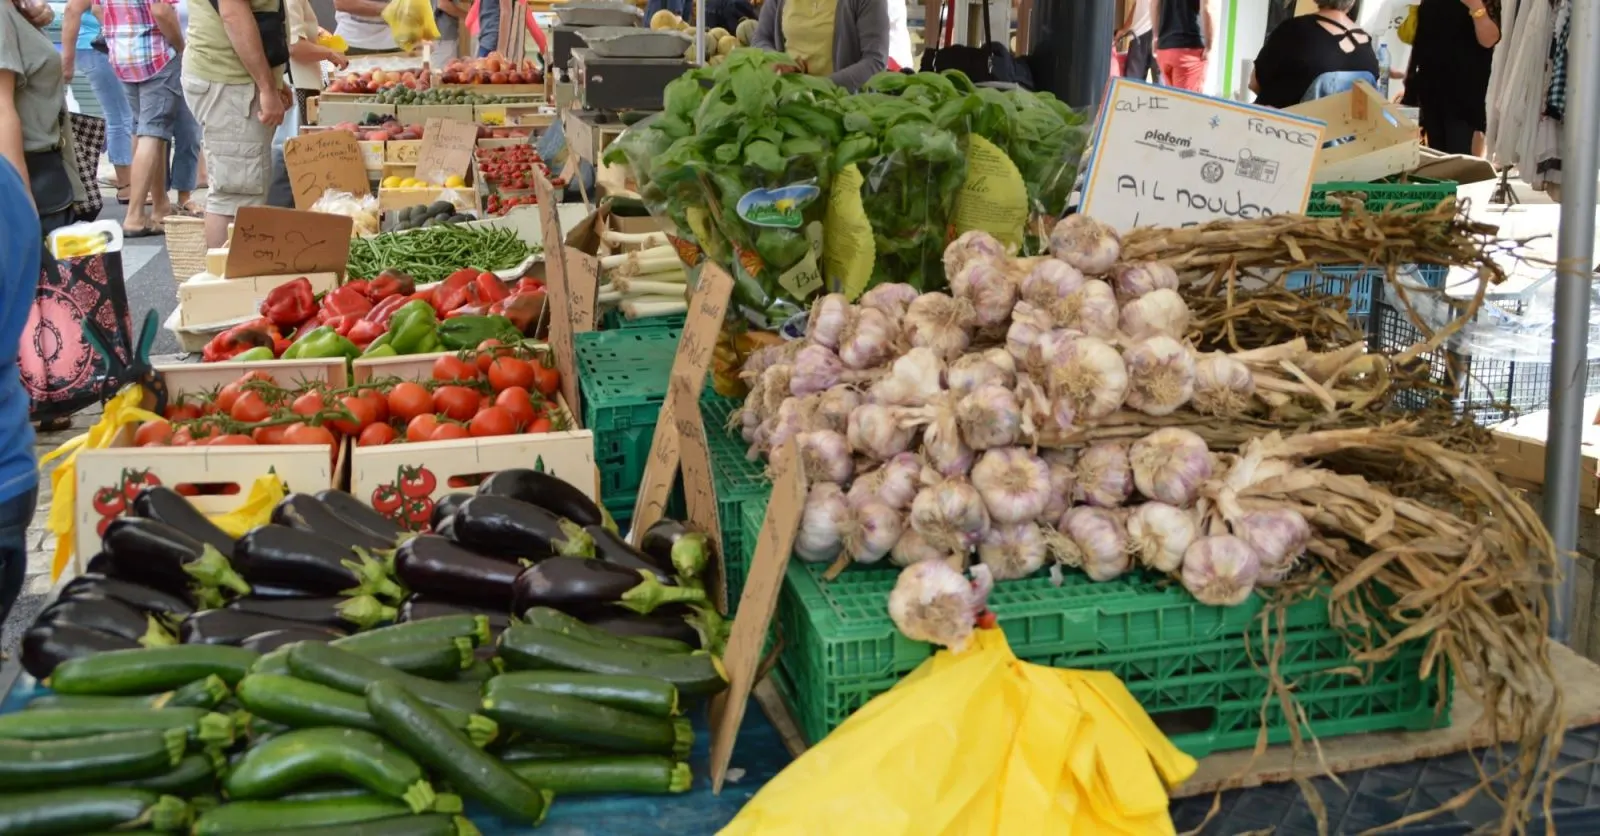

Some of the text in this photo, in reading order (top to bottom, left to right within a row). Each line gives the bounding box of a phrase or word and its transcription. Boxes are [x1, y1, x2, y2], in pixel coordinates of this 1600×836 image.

[1144, 129, 1192, 147] plaform
[1247, 117, 1318, 148] FRANCE
[1117, 174, 1165, 201] AIL
